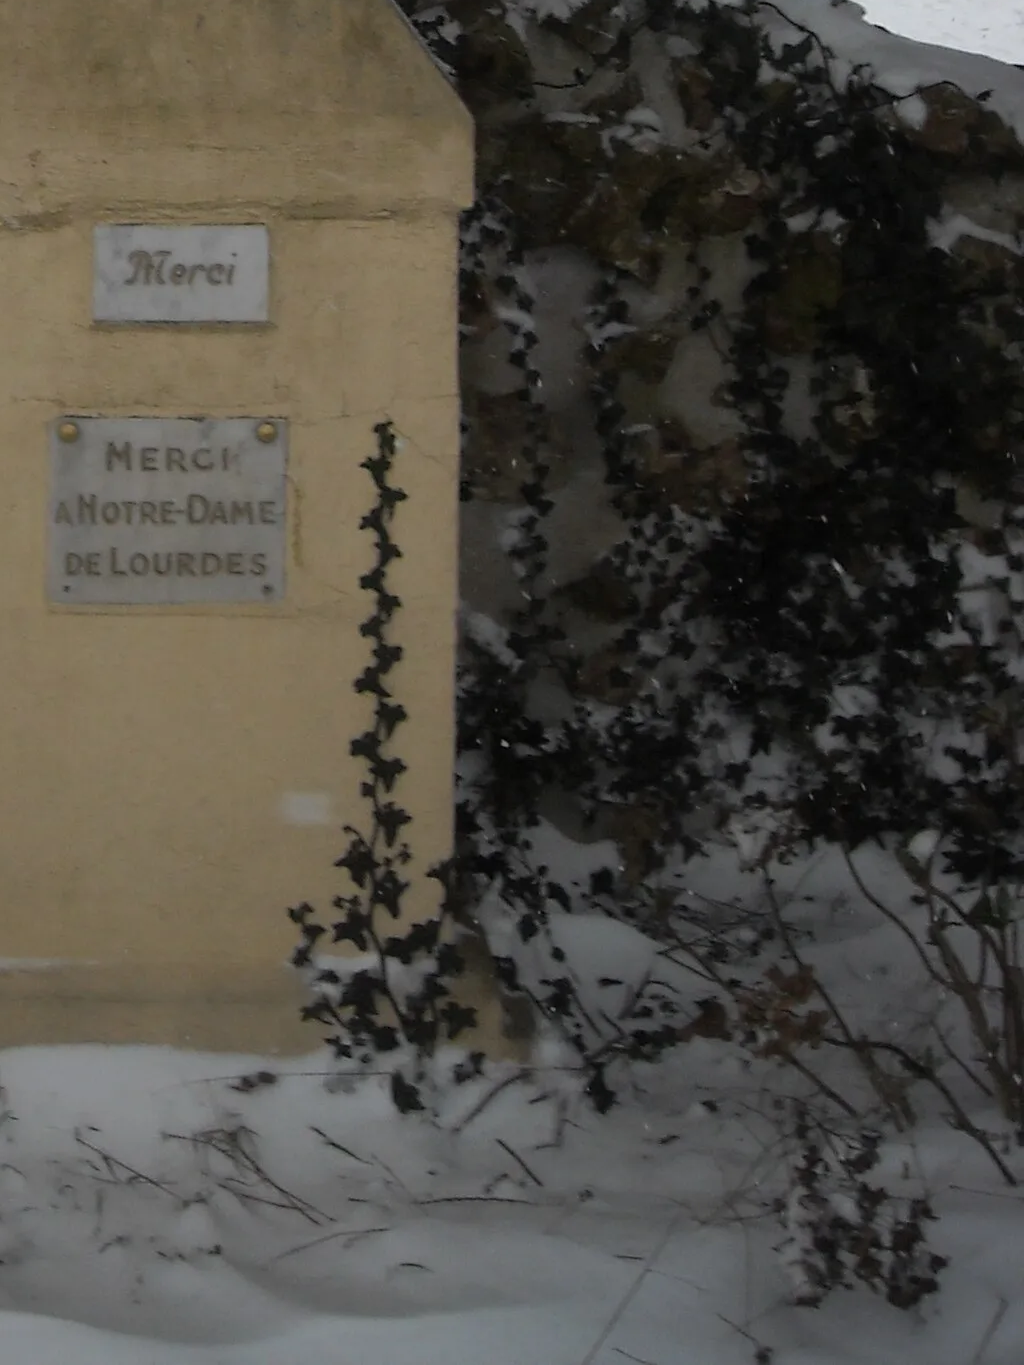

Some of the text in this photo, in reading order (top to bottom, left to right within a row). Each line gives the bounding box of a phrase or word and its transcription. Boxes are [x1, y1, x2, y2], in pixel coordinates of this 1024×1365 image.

[124, 249, 238, 286] Merci
[104, 441, 230, 472] MERCI
[77, 493, 277, 526] NOTRE-DAME
[65, 546, 268, 577] DE LOURDES
